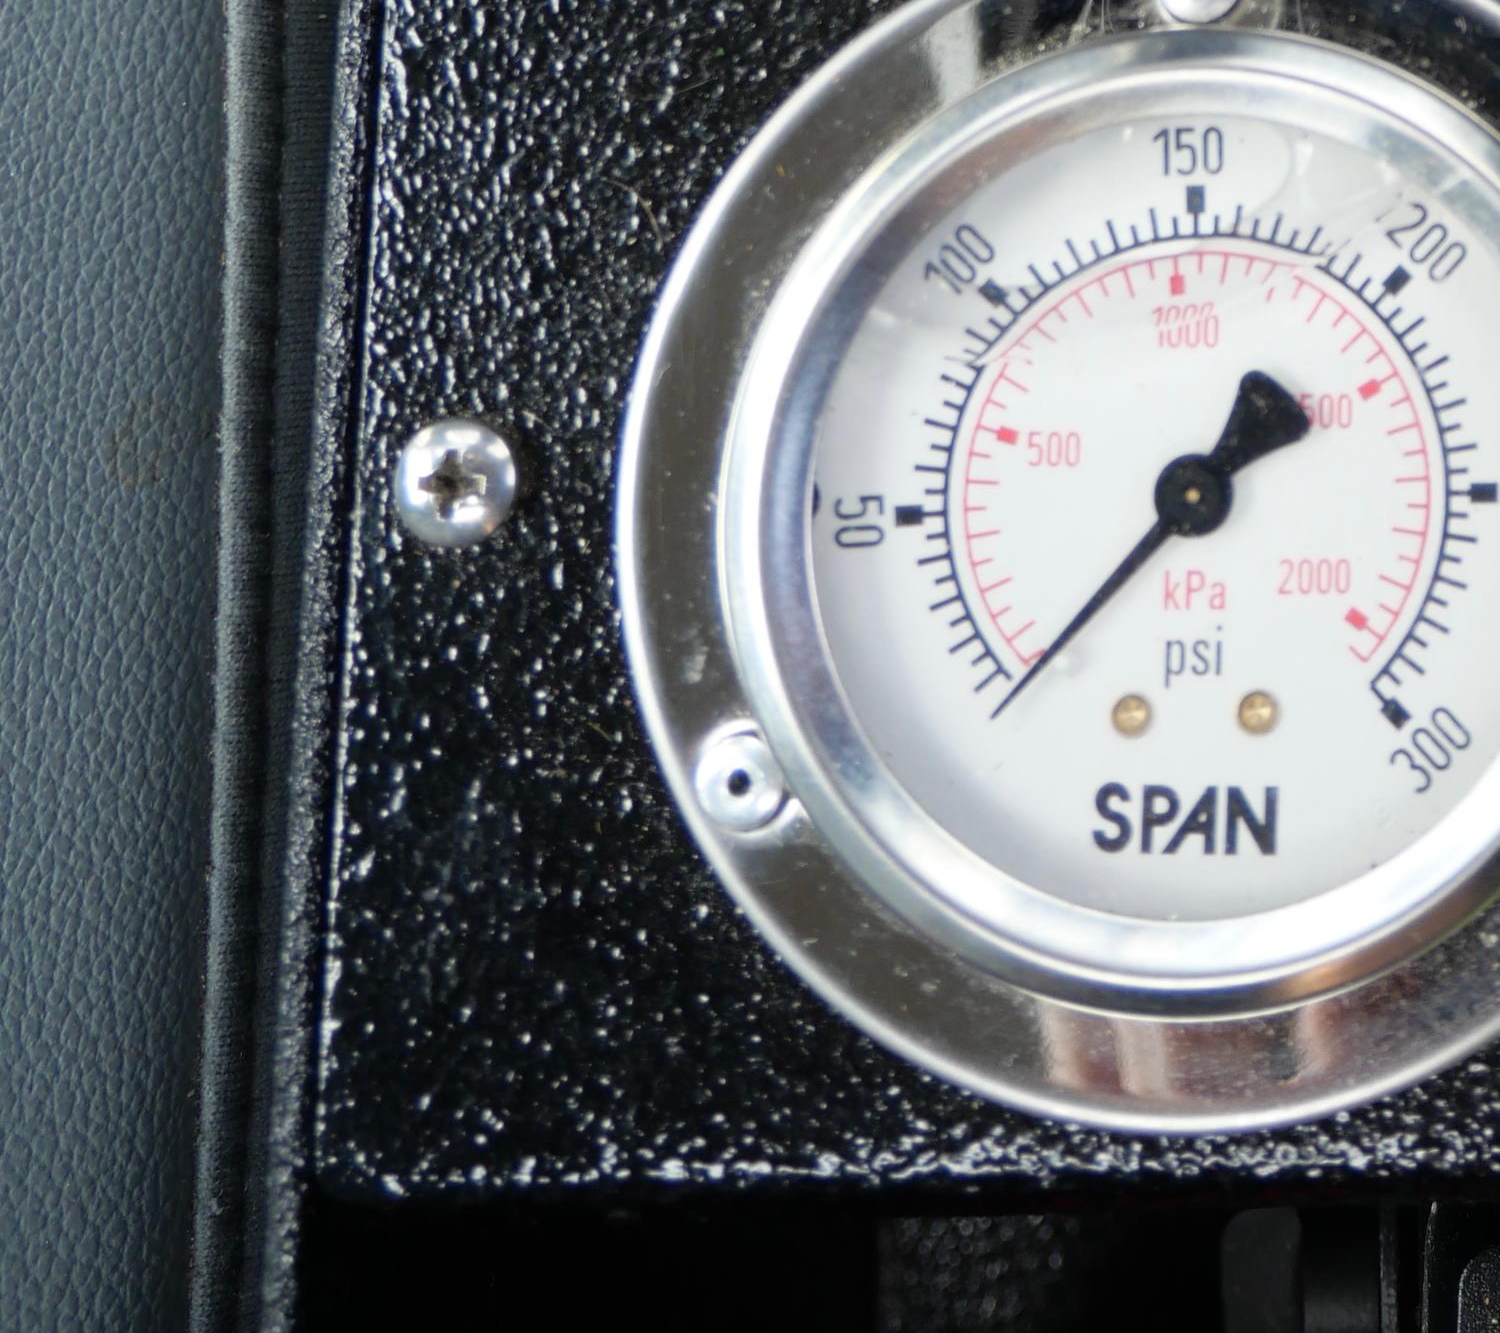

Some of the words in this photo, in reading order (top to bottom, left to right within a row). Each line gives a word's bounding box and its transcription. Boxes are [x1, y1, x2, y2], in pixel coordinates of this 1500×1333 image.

[1153, 126, 1224, 176] 150
[924, 223, 996, 295] 100
[1385, 203, 1468, 284] 200
[1027, 431, 1081, 468] 500
[833, 495, 886, 549] 50
[1162, 570, 1227, 612] kPa
[1278, 559, 1352, 595] 2000
[1164, 625, 1224, 689] psi
[1389, 706, 1473, 794] 300
[1093, 782, 1278, 856] SPAN
